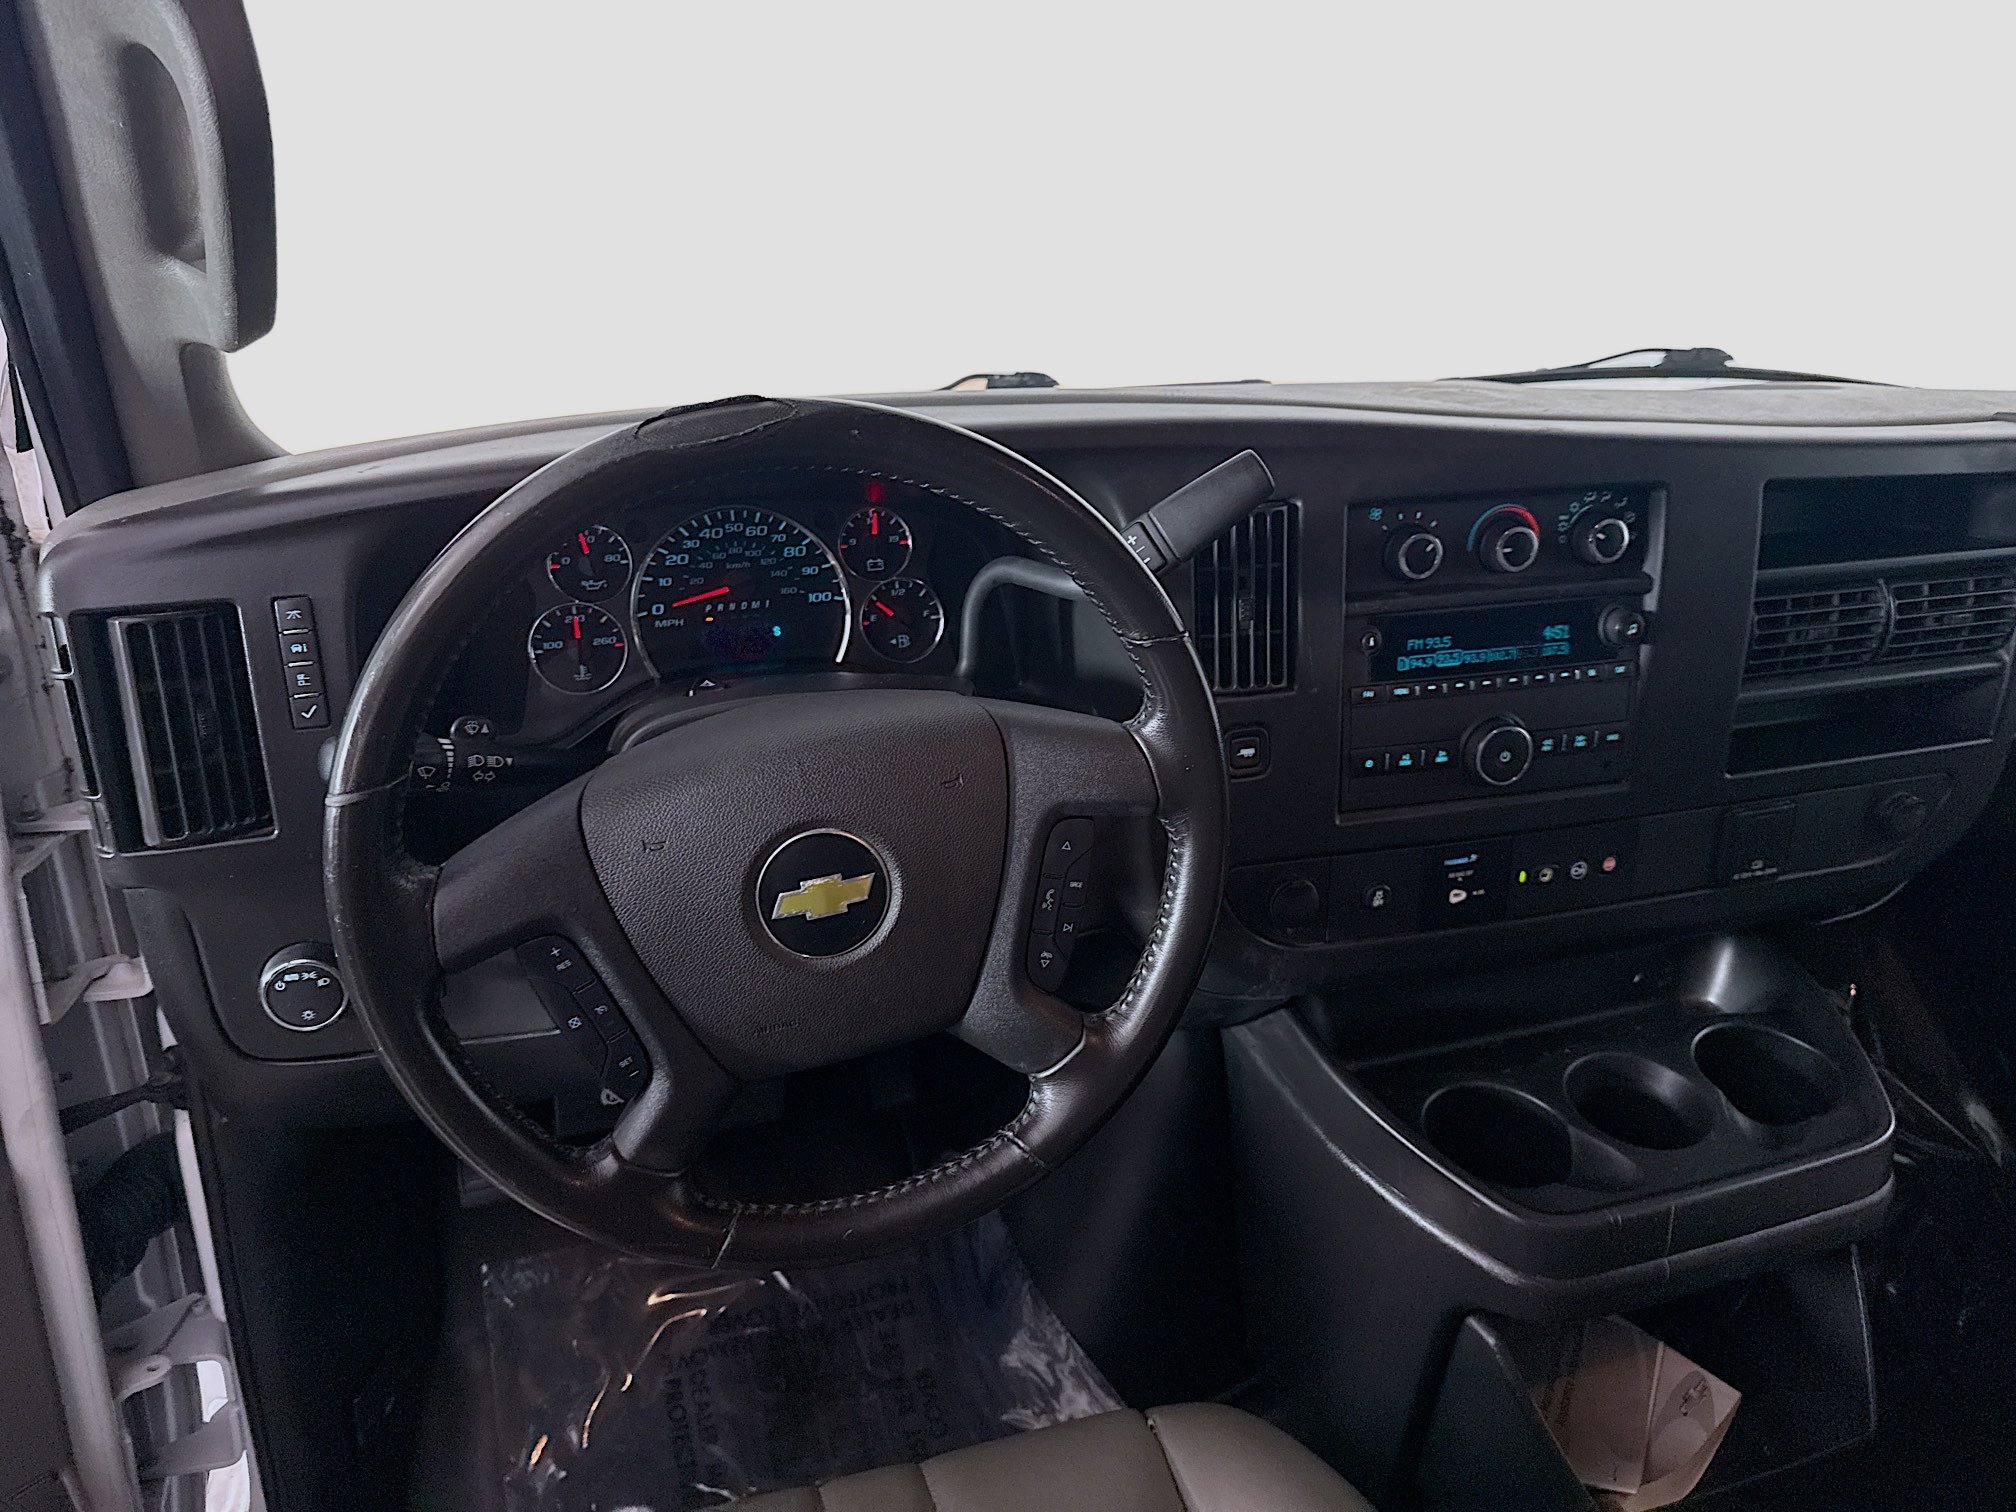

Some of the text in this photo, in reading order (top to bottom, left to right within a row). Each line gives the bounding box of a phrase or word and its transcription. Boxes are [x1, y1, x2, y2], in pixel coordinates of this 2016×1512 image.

[699, 527, 723, 539] 40
[725, 523, 743, 533] 50
[745, 525, 768, 537] 60
[770, 534, 786, 542] 70
[682, 540, 700, 549] 30
[712, 551, 727, 559] 60
[744, 549, 762, 557] 100
[783, 546, 807, 558] 80
[561, 557, 571, 566] 0
[665, 553, 689, 566] 20
[760, 558, 777, 566] 120
[698, 562, 713, 570] 40
[726, 561, 751, 569] km/h
[801, 566, 819, 576] 90
[659, 577, 673, 587] 10
[689, 577, 704, 585] 20
[780, 586, 797, 595] 160
[890, 588, 906, 597] 1/2
[808, 592, 832, 603] 100
[652, 604, 665, 616] 0
[654, 618, 684, 628] MPH
[543, 640, 563, 650] 100
[592, 635, 617, 646] 260
[1407, 636, 1453, 651] FM 93.5
